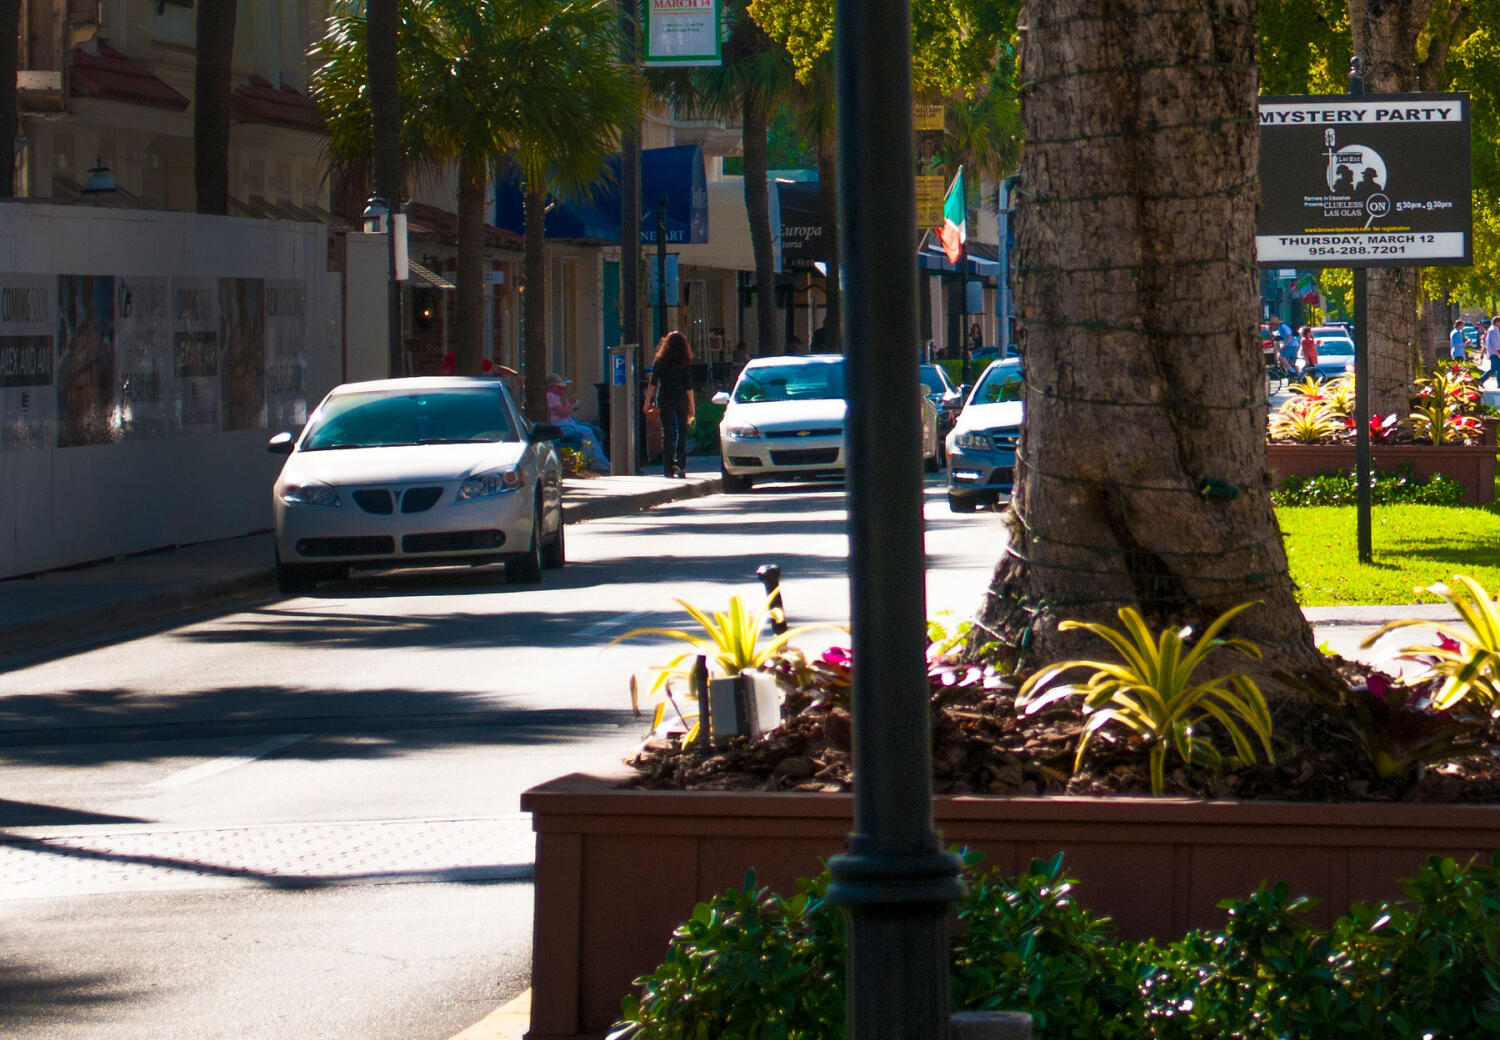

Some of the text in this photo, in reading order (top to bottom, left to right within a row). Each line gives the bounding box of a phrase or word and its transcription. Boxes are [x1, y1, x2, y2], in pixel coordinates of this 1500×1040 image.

[654, 0, 697, 8] MARCH
[1259, 108, 1453, 123] MYSTERY PARTY
[1323, 201, 1364, 209] CLUELESS
[1369, 202, 1386, 211] ON
[1279, 235, 1435, 246] THURSDAY, MARCH 12
[1309, 245, 1406, 255] 954-288.7201
[615, 357, 624, 369] P
